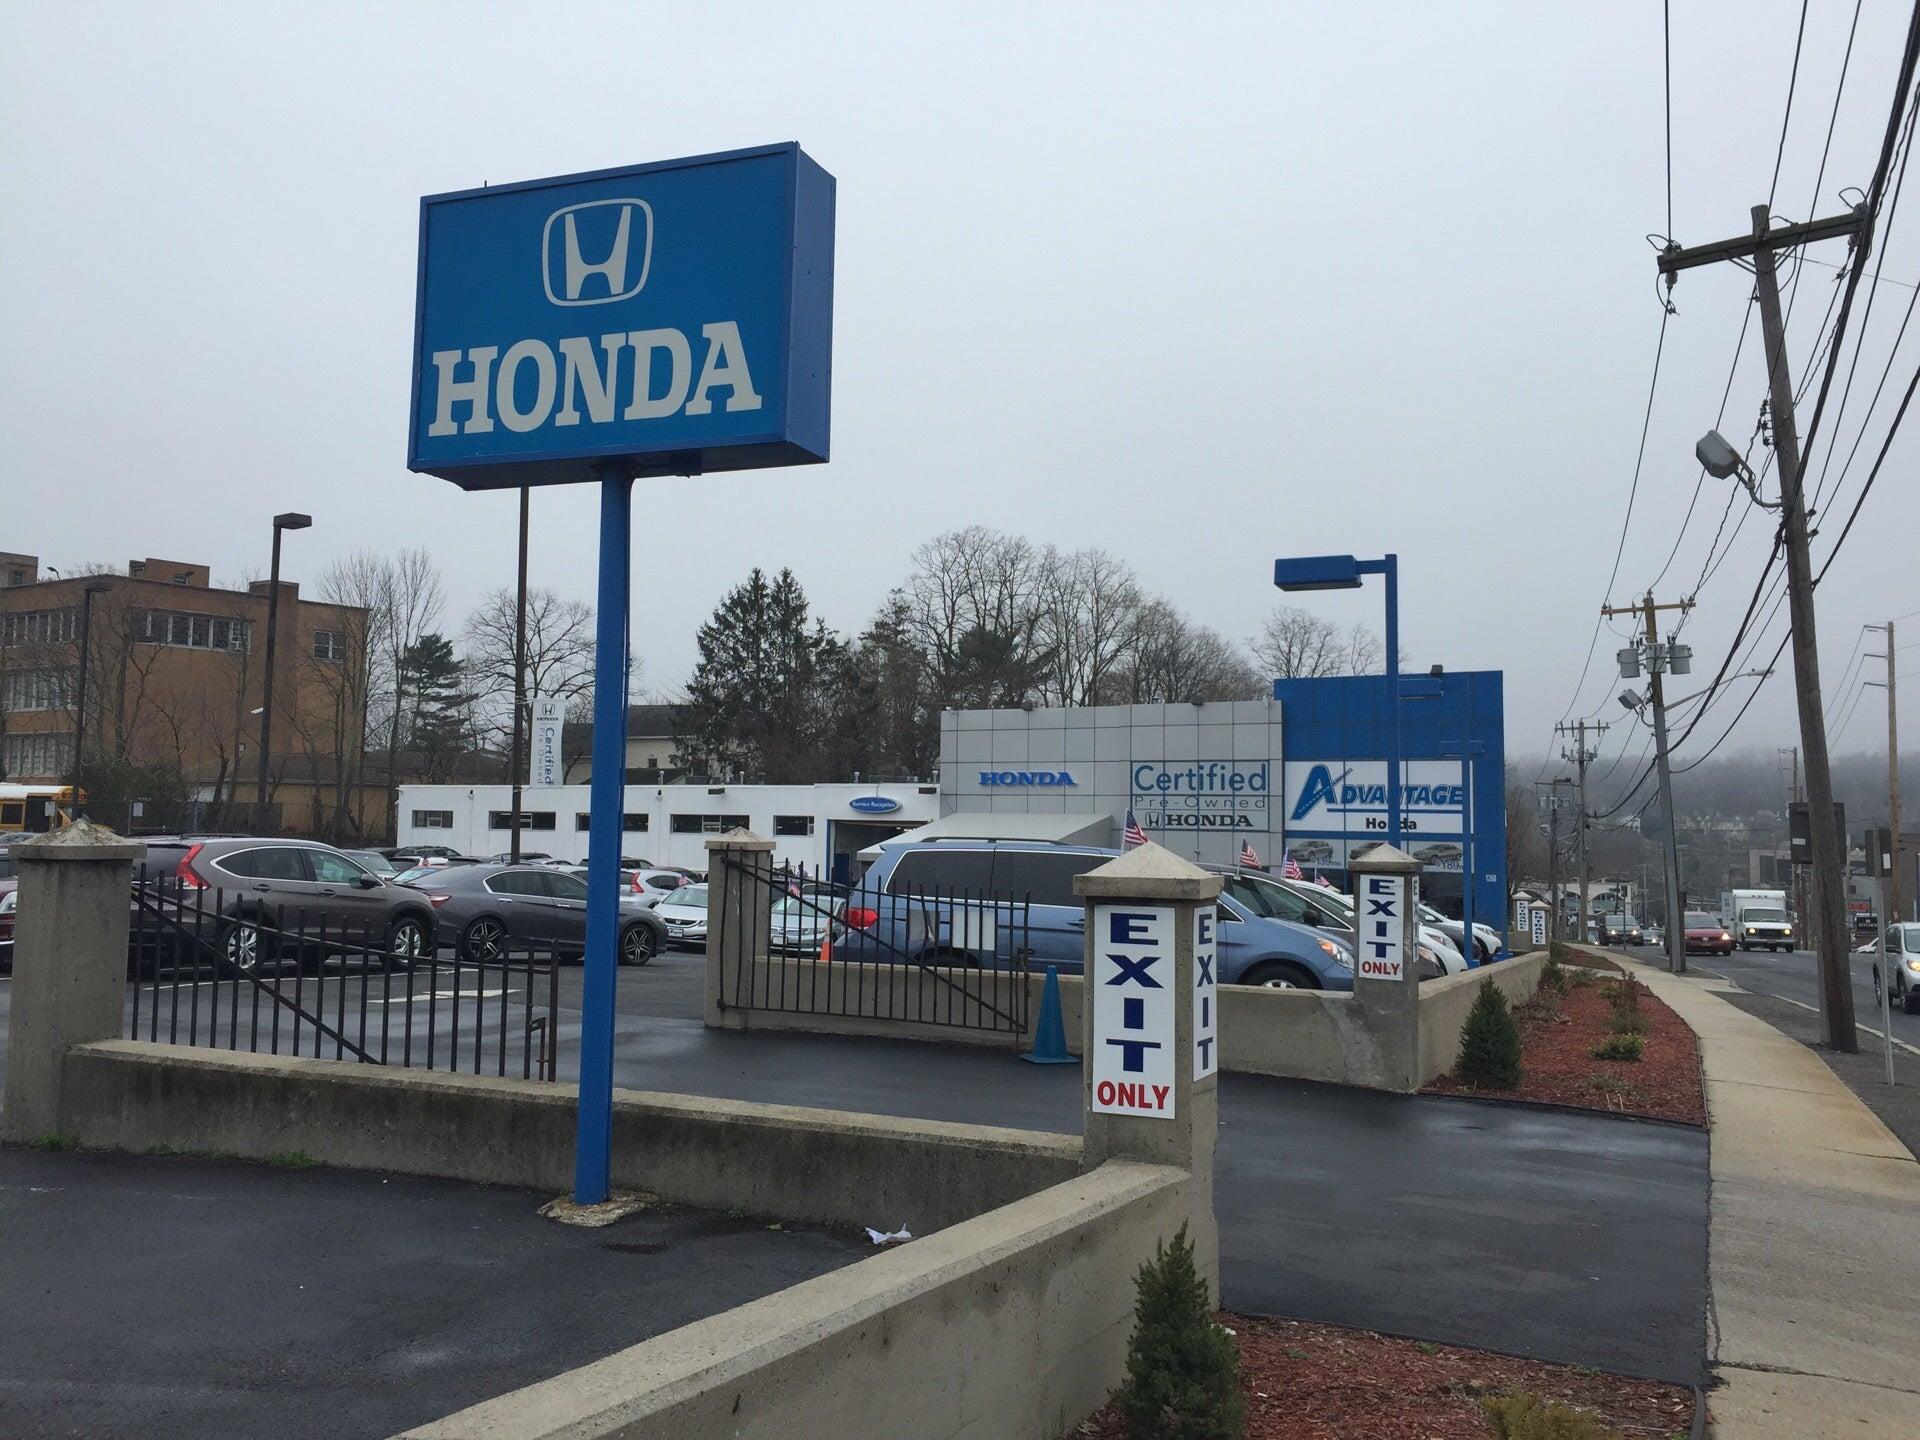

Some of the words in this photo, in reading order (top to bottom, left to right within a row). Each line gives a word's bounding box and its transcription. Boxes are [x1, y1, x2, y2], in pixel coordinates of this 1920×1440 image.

[428, 320, 763, 438] HONDA
[545, 727, 555, 785] Certified
[979, 772, 1077, 786] HONDA
[1134, 763, 1267, 791] Certified
[1290, 763, 1464, 821] ADVATAGE
[1134, 795, 1265, 808] Pre-Owned
[1166, 814, 1254, 827] HONDA
[1366, 818, 1417, 830] Hoda
[1366, 878, 1397, 958] EXIT
[1361, 961, 1400, 975] ONLY
[1105, 912, 1164, 1073] EXIT
[1197, 913, 1214, 1070] EXIT
[1097, 1080, 1170, 1110] ONLY
